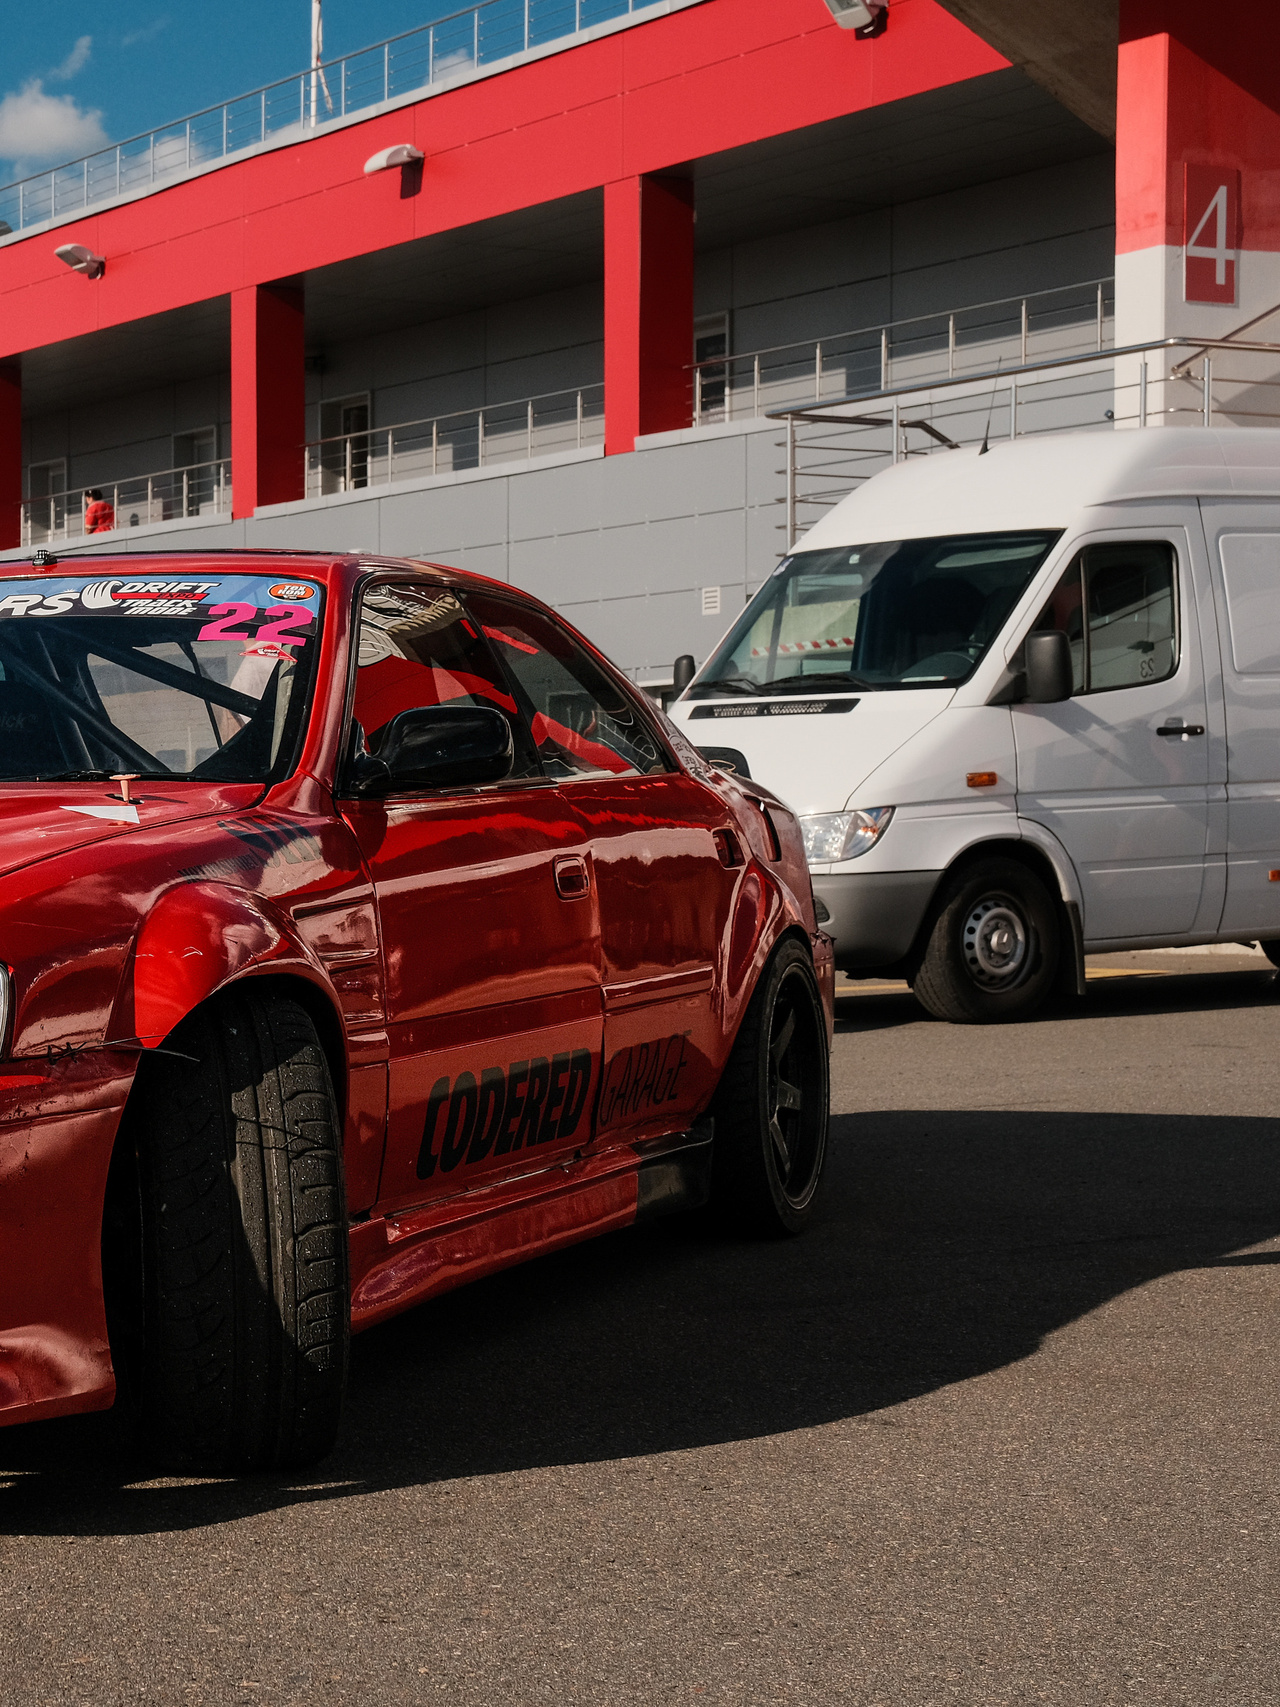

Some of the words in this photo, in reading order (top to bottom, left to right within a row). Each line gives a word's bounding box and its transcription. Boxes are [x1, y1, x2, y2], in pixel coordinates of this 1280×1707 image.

[1186, 185, 1235, 285] 4
[117, 582, 221, 594] DRIFT
[197, 602, 314, 647] 22
[416, 1047, 593, 1181] CODERED
[598, 1029, 694, 1127] GARAGE
